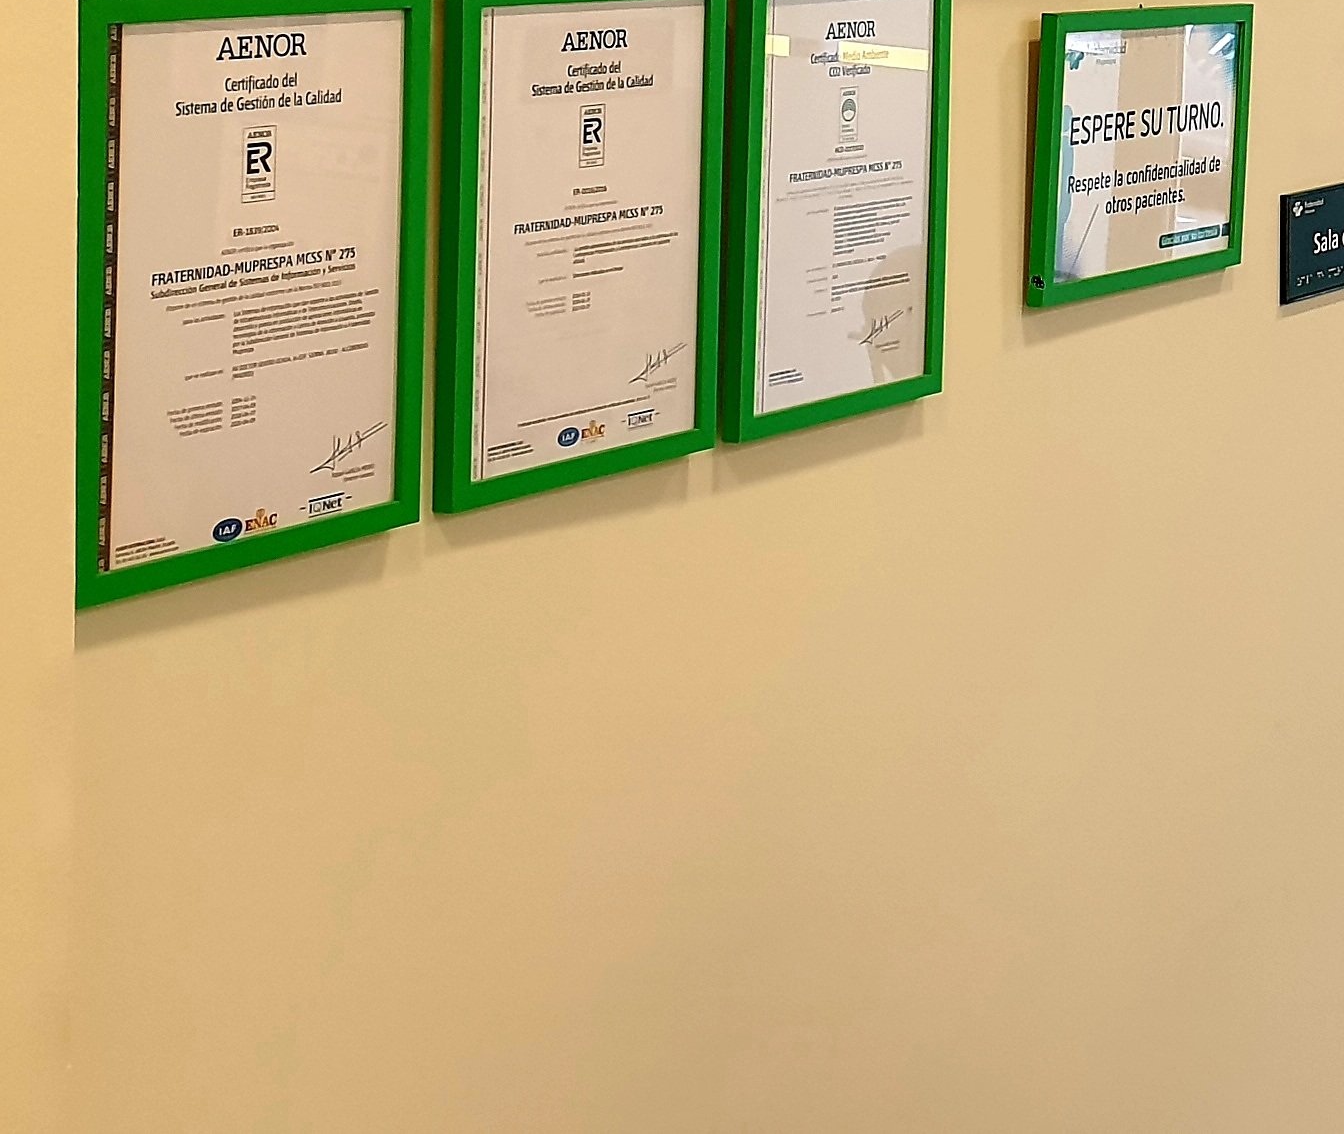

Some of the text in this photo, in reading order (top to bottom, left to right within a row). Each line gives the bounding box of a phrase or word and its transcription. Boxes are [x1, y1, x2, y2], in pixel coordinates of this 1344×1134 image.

[561, 29, 628, 52] AENOR
[826, 21, 876, 40] AENOR
[216, 33, 307, 61] AENOR
[811, 52, 841, 65] Certificad
[567, 61, 621, 78] Certificado del
[225, 72, 298, 94] Certificado del
[532, 75, 654, 97] Sistema de Gestión de la Calidad
[175, 88, 342, 116] Sistema de Gestión de la Calidad
[583, 117, 602, 144] ER
[1070, 101, 1224, 146] ESPERE SU TURNO.
[246, 142, 272, 174] ER
[1067, 155, 1221, 196] Respete la confidencialidad de
[1105, 187, 1185, 214] otros pacientes.
[514, 211, 617, 234] FRATERNIDAD-MUPRESPA
[619, 207, 639, 220] MCSS
[1313, 228, 1339, 254] Sala
[151, 255, 293, 286] FRATERNIDAD-MUPRESPA
[297, 250, 322, 265] MCSS
[339, 247, 356, 260] 275
[199, 280, 227, 293] General
[229, 278, 238, 288] de
[271, 272, 279, 282] de
[219, 524, 238, 536] IAF
[245, 512, 277, 532] ENAC
